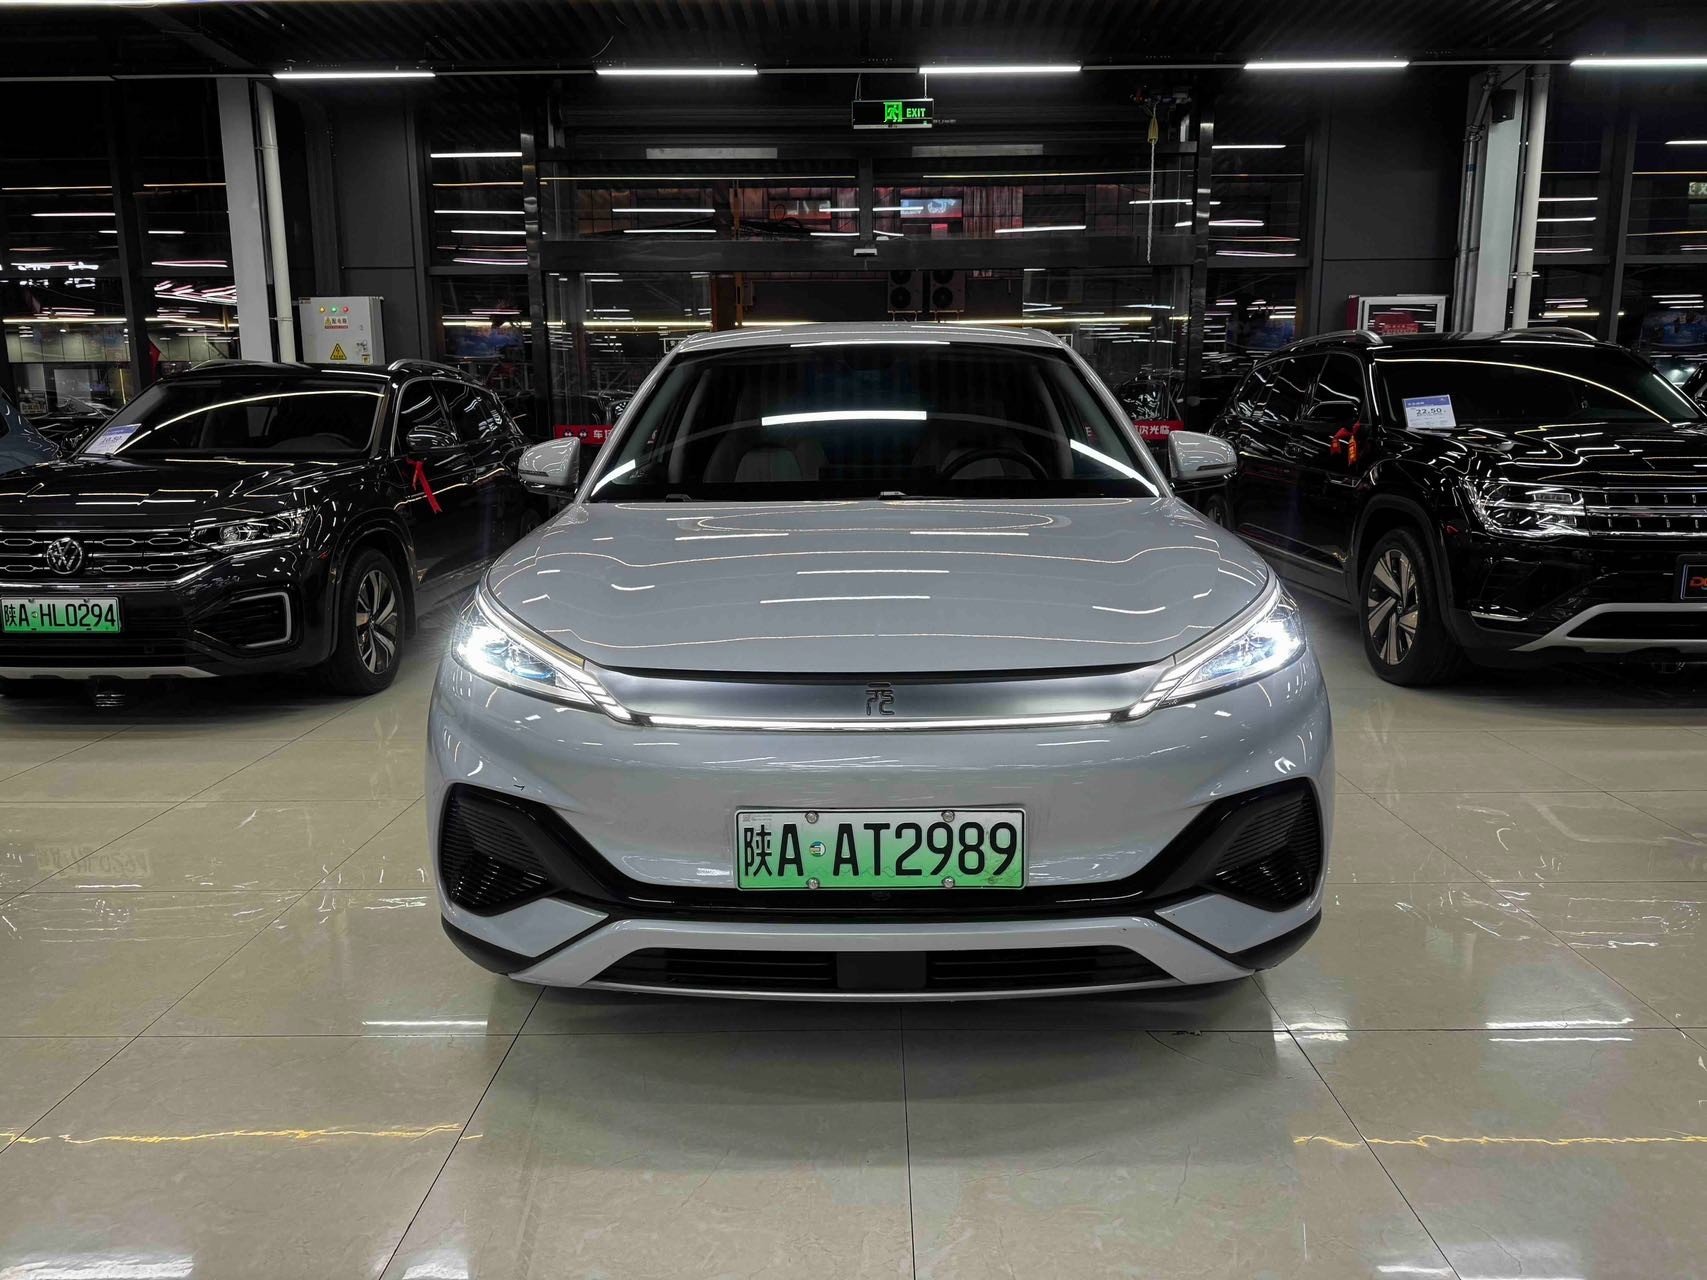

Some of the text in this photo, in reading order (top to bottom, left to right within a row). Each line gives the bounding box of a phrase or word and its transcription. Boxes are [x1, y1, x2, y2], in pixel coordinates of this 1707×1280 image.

[906, 108, 926, 118] EXIT
[3, 603, 117, 628] 陕A HL0294
[743, 821, 1018, 877] 陕A AT2989
